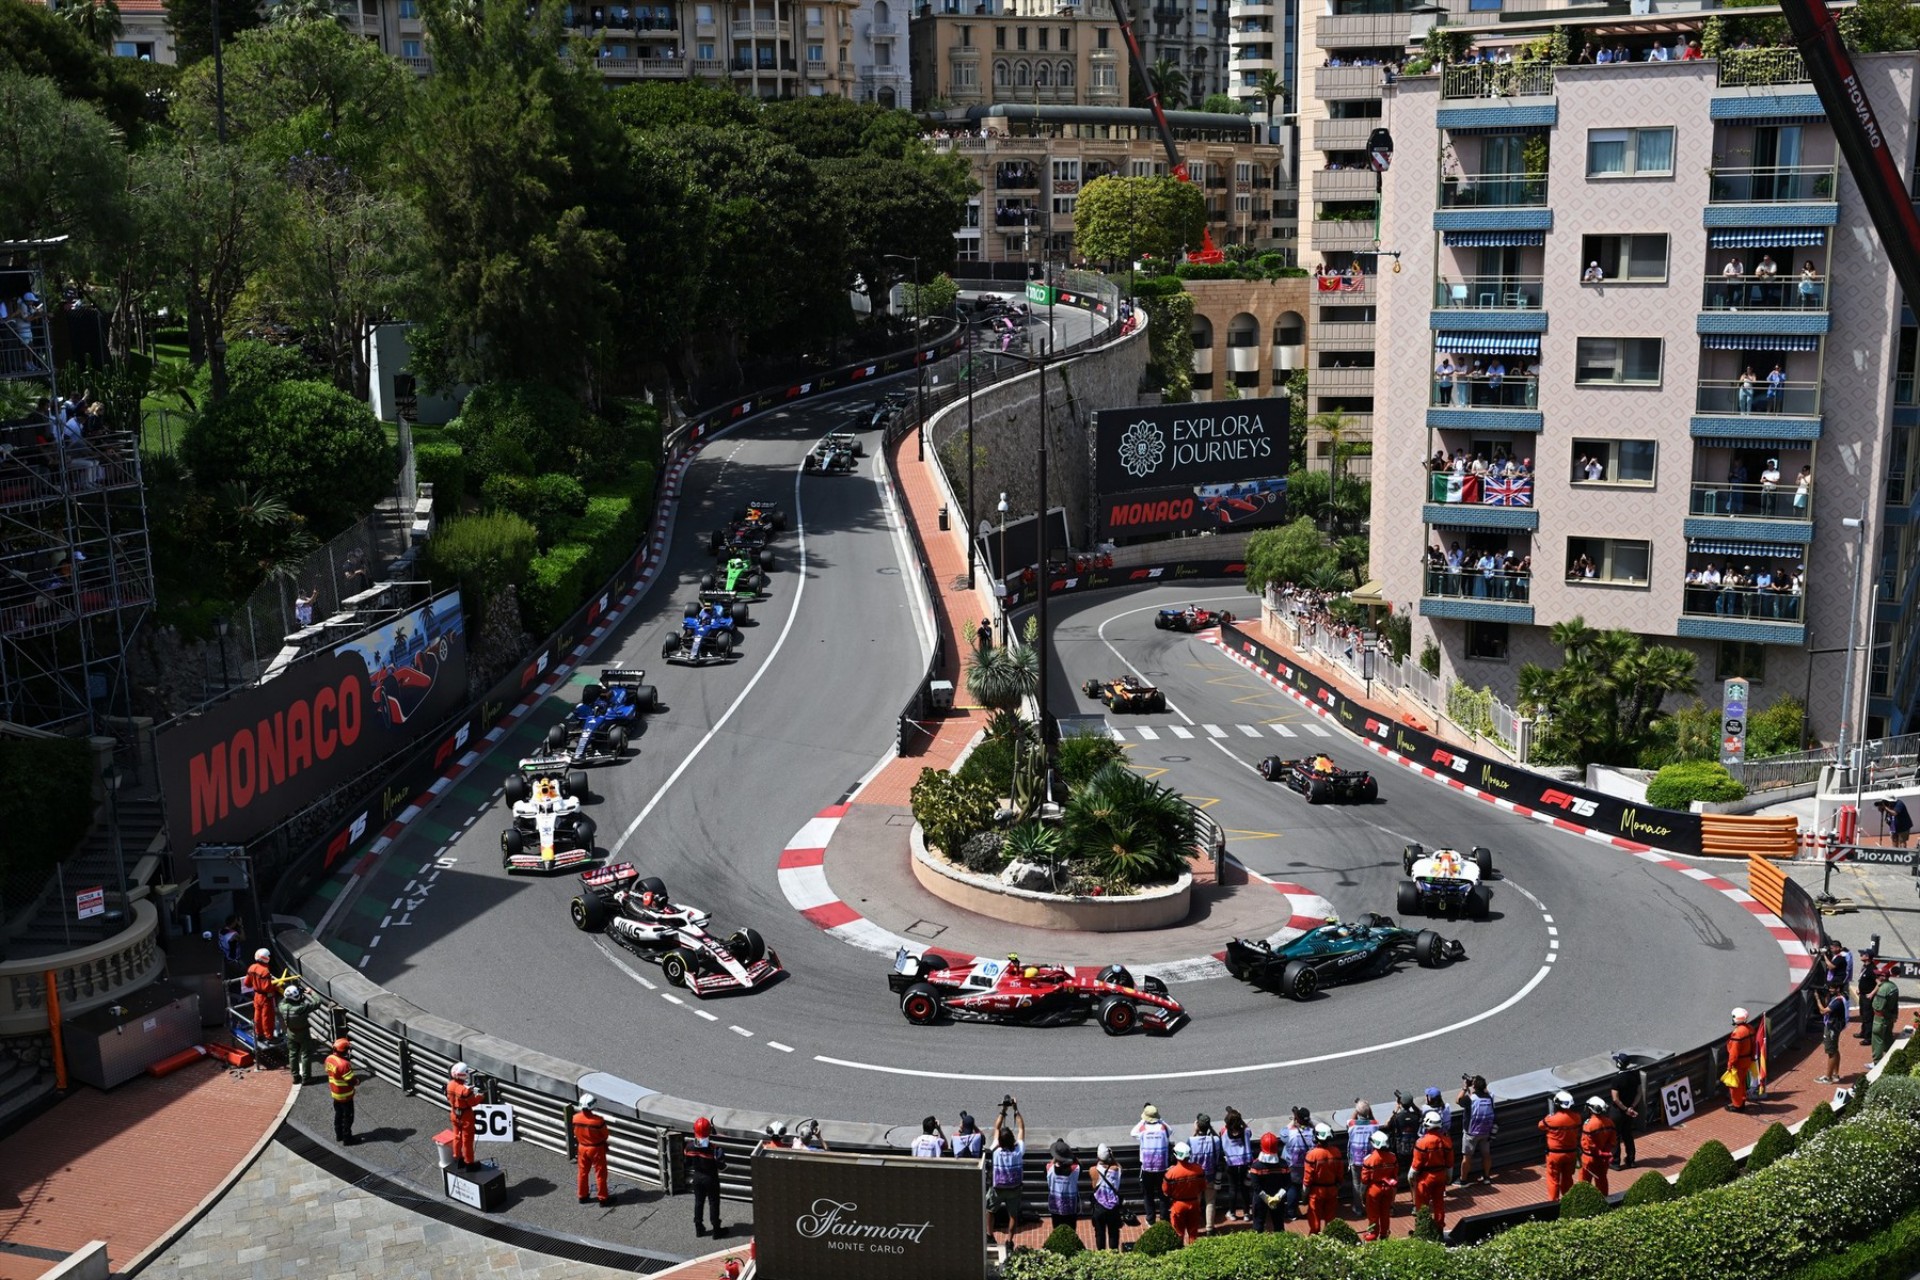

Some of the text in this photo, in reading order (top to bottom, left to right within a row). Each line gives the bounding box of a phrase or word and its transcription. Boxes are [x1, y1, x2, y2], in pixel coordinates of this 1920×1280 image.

[1844, 75, 1881, 148] PIOVANO
[1173, 414, 1264, 441] EXPLORA
[1170, 437, 1271, 471] JOURNEYS
[1109, 498, 1194, 527] MONACO
[189, 675, 362, 837] MONACO
[1481, 764, 1511, 791] Monaco
[1620, 808, 1671, 838] Monaco
[1855, 849, 1913, 863] PIOVANO
[1337, 950, 1368, 967] aramco
[1666, 1085, 1691, 1118] SC
[473, 1109, 508, 1137] SC
[796, 1198, 935, 1244] Fairmont
[827, 1240, 905, 1255] MONTE CARLO
